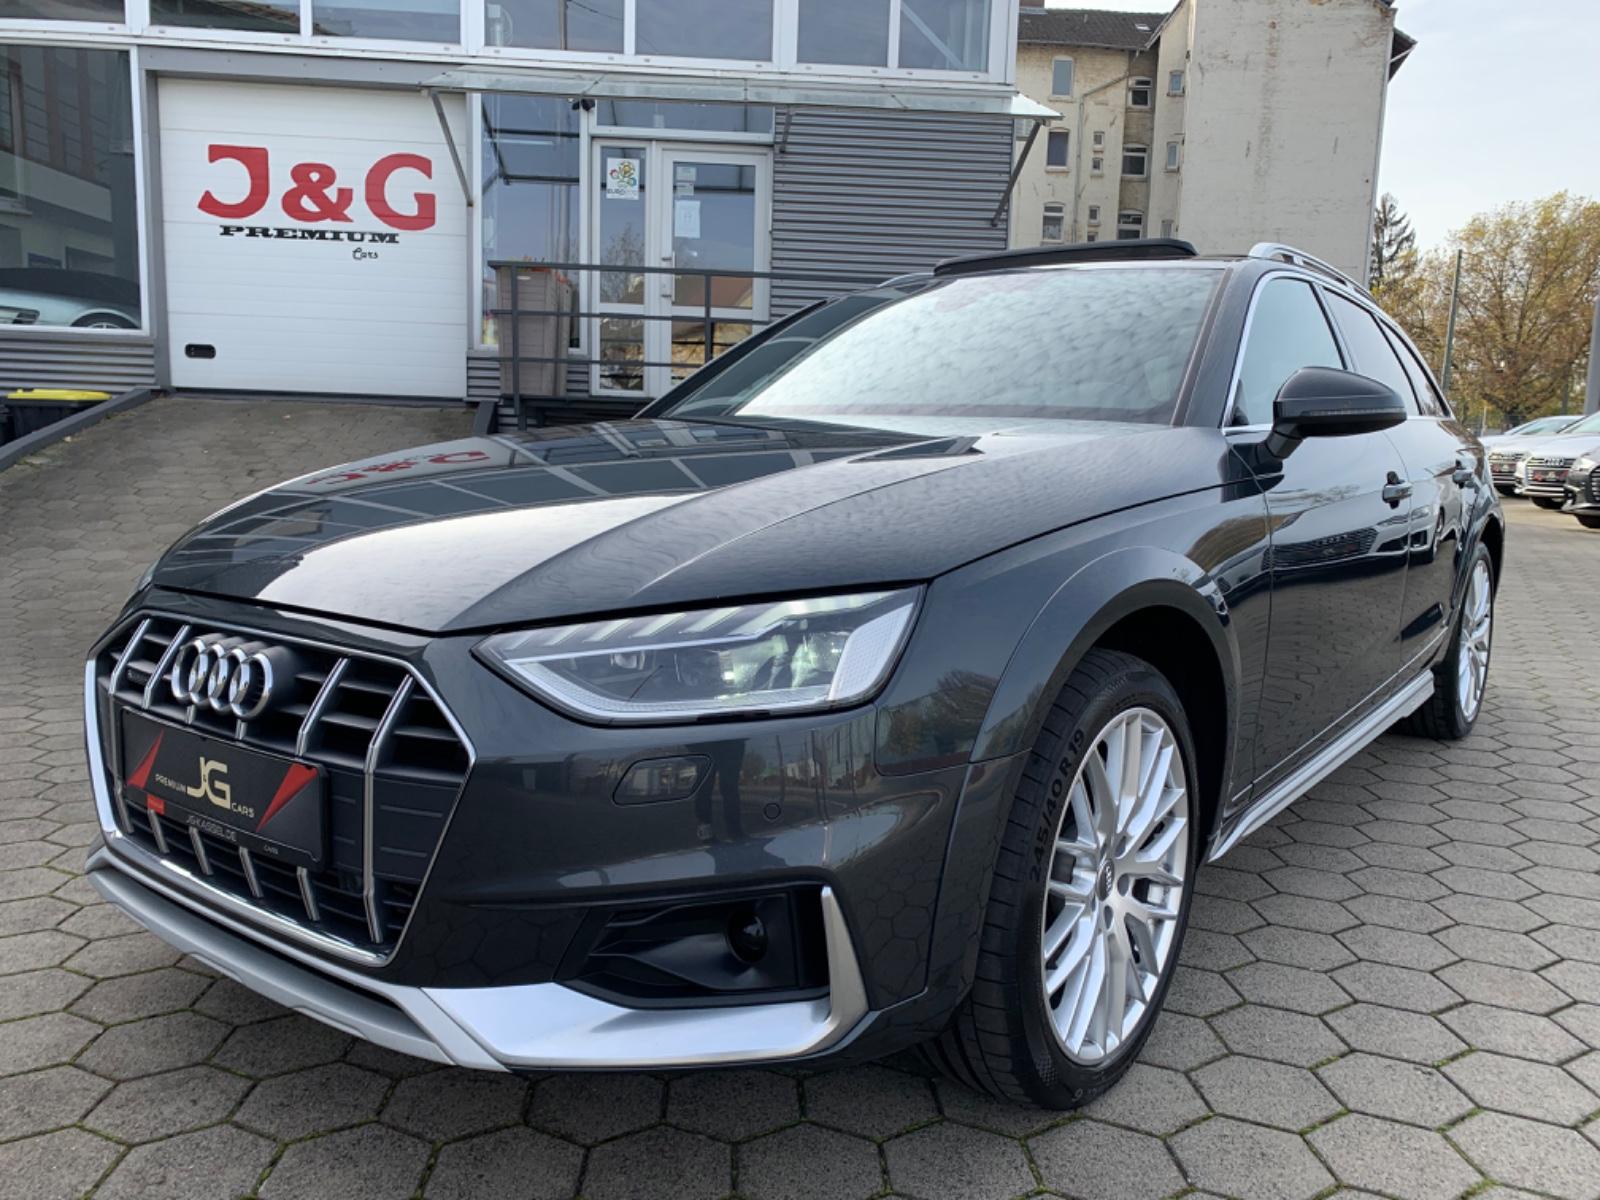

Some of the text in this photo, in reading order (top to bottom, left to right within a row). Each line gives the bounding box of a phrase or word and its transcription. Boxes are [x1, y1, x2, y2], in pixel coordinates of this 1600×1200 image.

[197, 144, 436, 231] J&G
[219, 225, 399, 244] PREMIUM
[352, 247, 378, 260] Cars
[155, 773, 187, 793] PREMIUM
[232, 802, 255, 818] CARS
